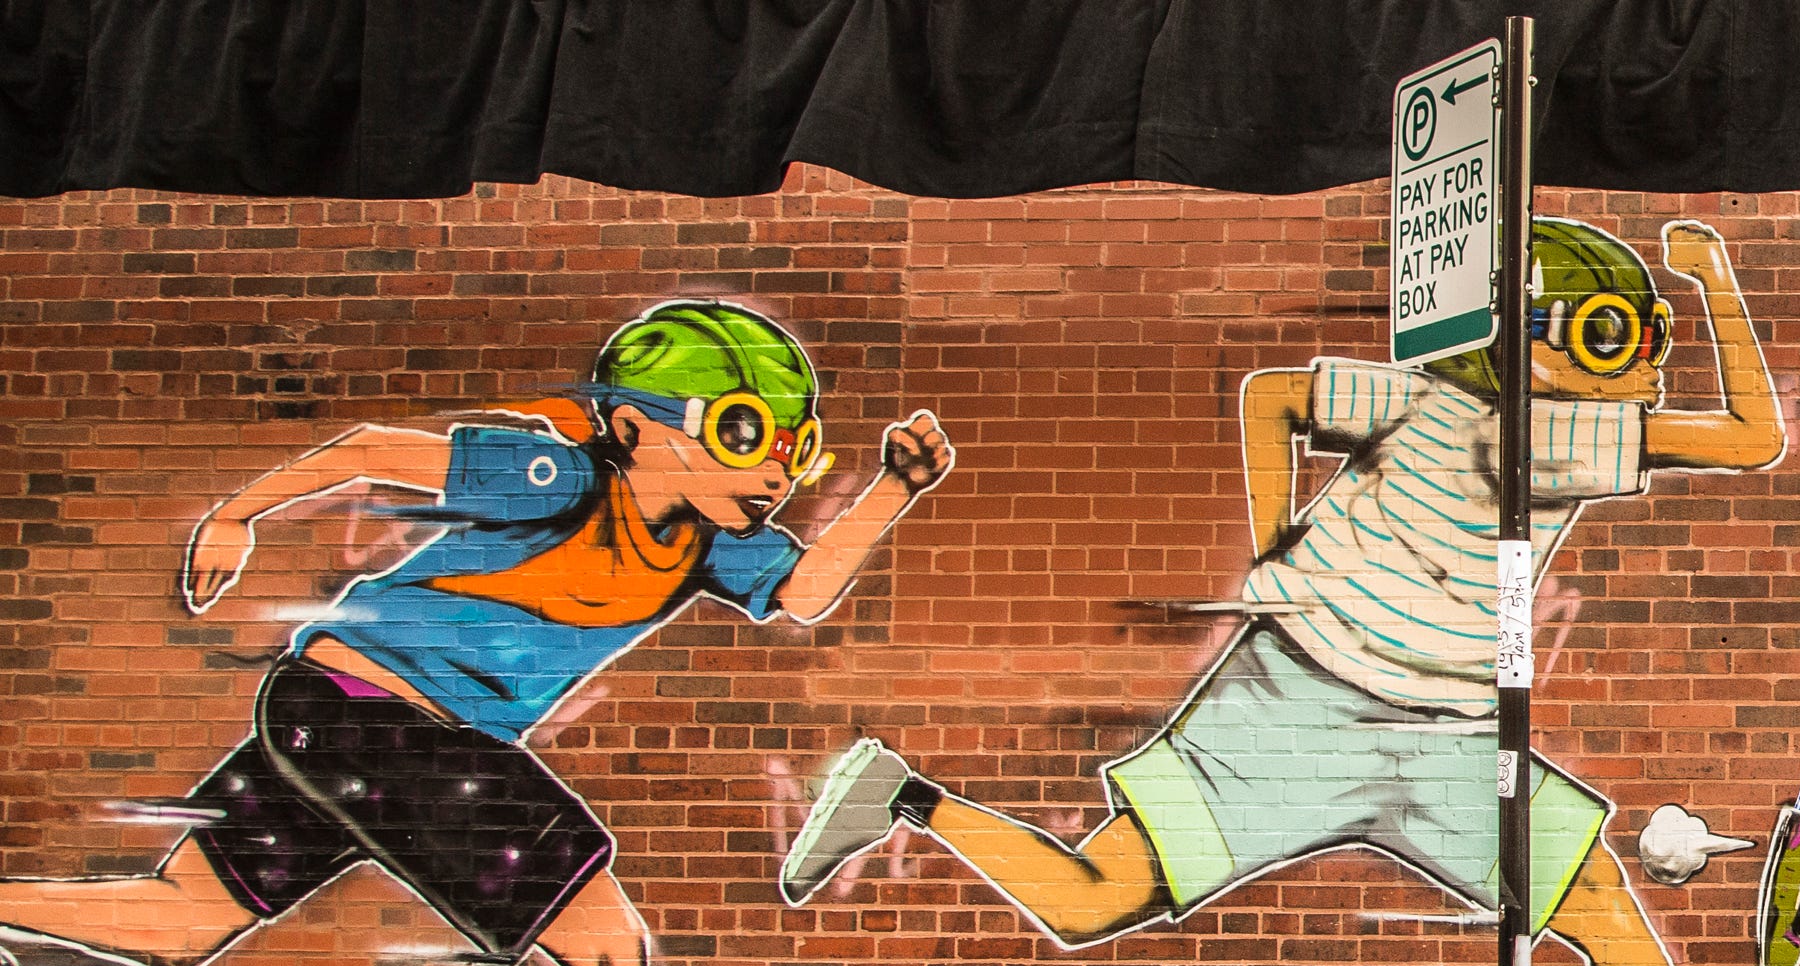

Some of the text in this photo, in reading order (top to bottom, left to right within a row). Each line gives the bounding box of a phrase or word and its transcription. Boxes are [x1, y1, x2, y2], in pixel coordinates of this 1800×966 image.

[1400, 157, 1483, 214] PAY FOR
[1400, 192, 1488, 250] PARKING
[1400, 234, 1469, 284] AT PAY
[1400, 280, 1437, 319] BOX
